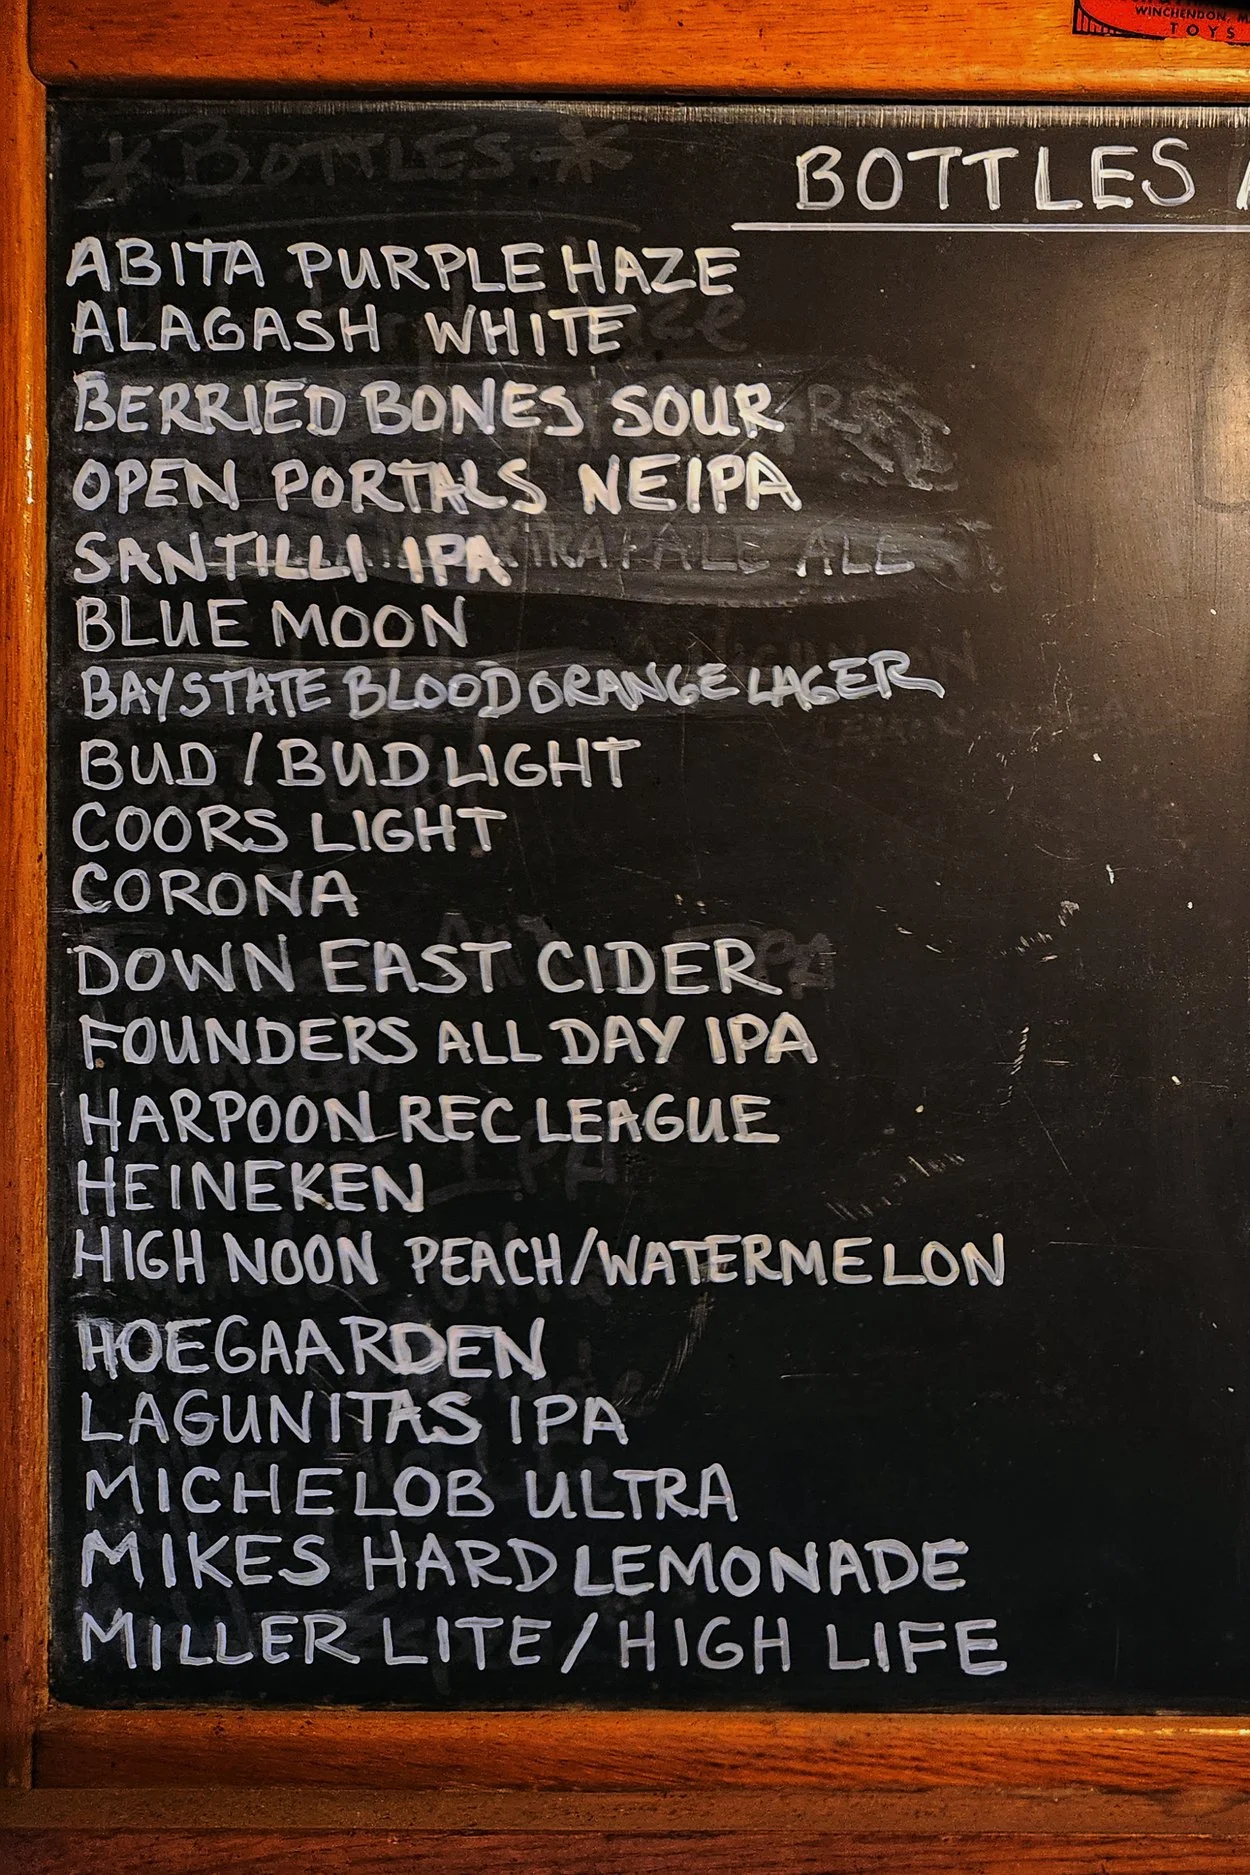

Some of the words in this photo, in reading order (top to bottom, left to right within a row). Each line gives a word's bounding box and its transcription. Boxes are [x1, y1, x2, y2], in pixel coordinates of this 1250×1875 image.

[1135, 6, 1231, 22] WINCHENDON,
[1170, 22, 1235, 39] TOYS
[796, 138, 1195, 210] BOTTLES
[66, 237, 265, 291] ABITA
[287, 242, 545, 293] PURPLE
[561, 240, 740, 295] HAZE
[71, 300, 380, 354] ALAGASH
[425, 304, 636, 356] WHITE
[73, 371, 346, 436] BERRIED
[360, 378, 584, 436] BONES
[608, 383, 785, 438] SOUR
[73, 458, 239, 514] OPEN
[272, 459, 546, 514] PORTALS
[578, 452, 802, 514] NEIPA
[74, 531, 367, 584] SANTILLI
[398, 534, 512, 586] IPA
[76, 595, 249, 652] BLUE
[272, 596, 468, 647] MOON
[349, 661, 521, 720] BLOOD
[528, 662, 740, 713] ORANGE
[747, 650, 945, 712] LAGER
[81, 739, 216, 790] BUD
[277, 739, 429, 786] BUD
[444, 737, 641, 788] LIGHT
[73, 802, 288, 852] COORS
[312, 804, 507, 852] LIGHT
[69, 862, 359, 917] CORONA
[73, 934, 295, 995] DOWN
[320, 939, 512, 993] EAST
[538, 938, 782, 995] CIDER
[79, 1015, 417, 1069] FOUNDERS
[439, 1020, 542, 1064] ALL
[549, 1016, 685, 1064] DAY
[706, 1012, 818, 1064] IPA
[79, 1088, 372, 1145] HARPOON
[400, 1095, 520, 1143] REC
[536, 1094, 780, 1143] LEAGUE
[77, 1157, 424, 1217] HEINEKEN
[73, 1226, 205, 1284] HIGH
[228, 1231, 378, 1285] NOON
[75, 1315, 546, 1380] HOEGAARDEN
[81, 1389, 482, 1446] LAGUNITAS
[511, 1395, 628, 1445] IPA
[86, 1464, 494, 1516] MICHELOB
[526, 1463, 738, 1521] ULTRA
[81, 1530, 330, 1589] MIKES
[364, 1530, 557, 1592] HARD
[574, 1539, 968, 1597] LEMONADE
[81, 1608, 360, 1671] MILLER
[383, 1616, 551, 1670] LITE
[620, 1611, 790, 1674] HIGH
[827, 1619, 1007, 1675] LIFE
